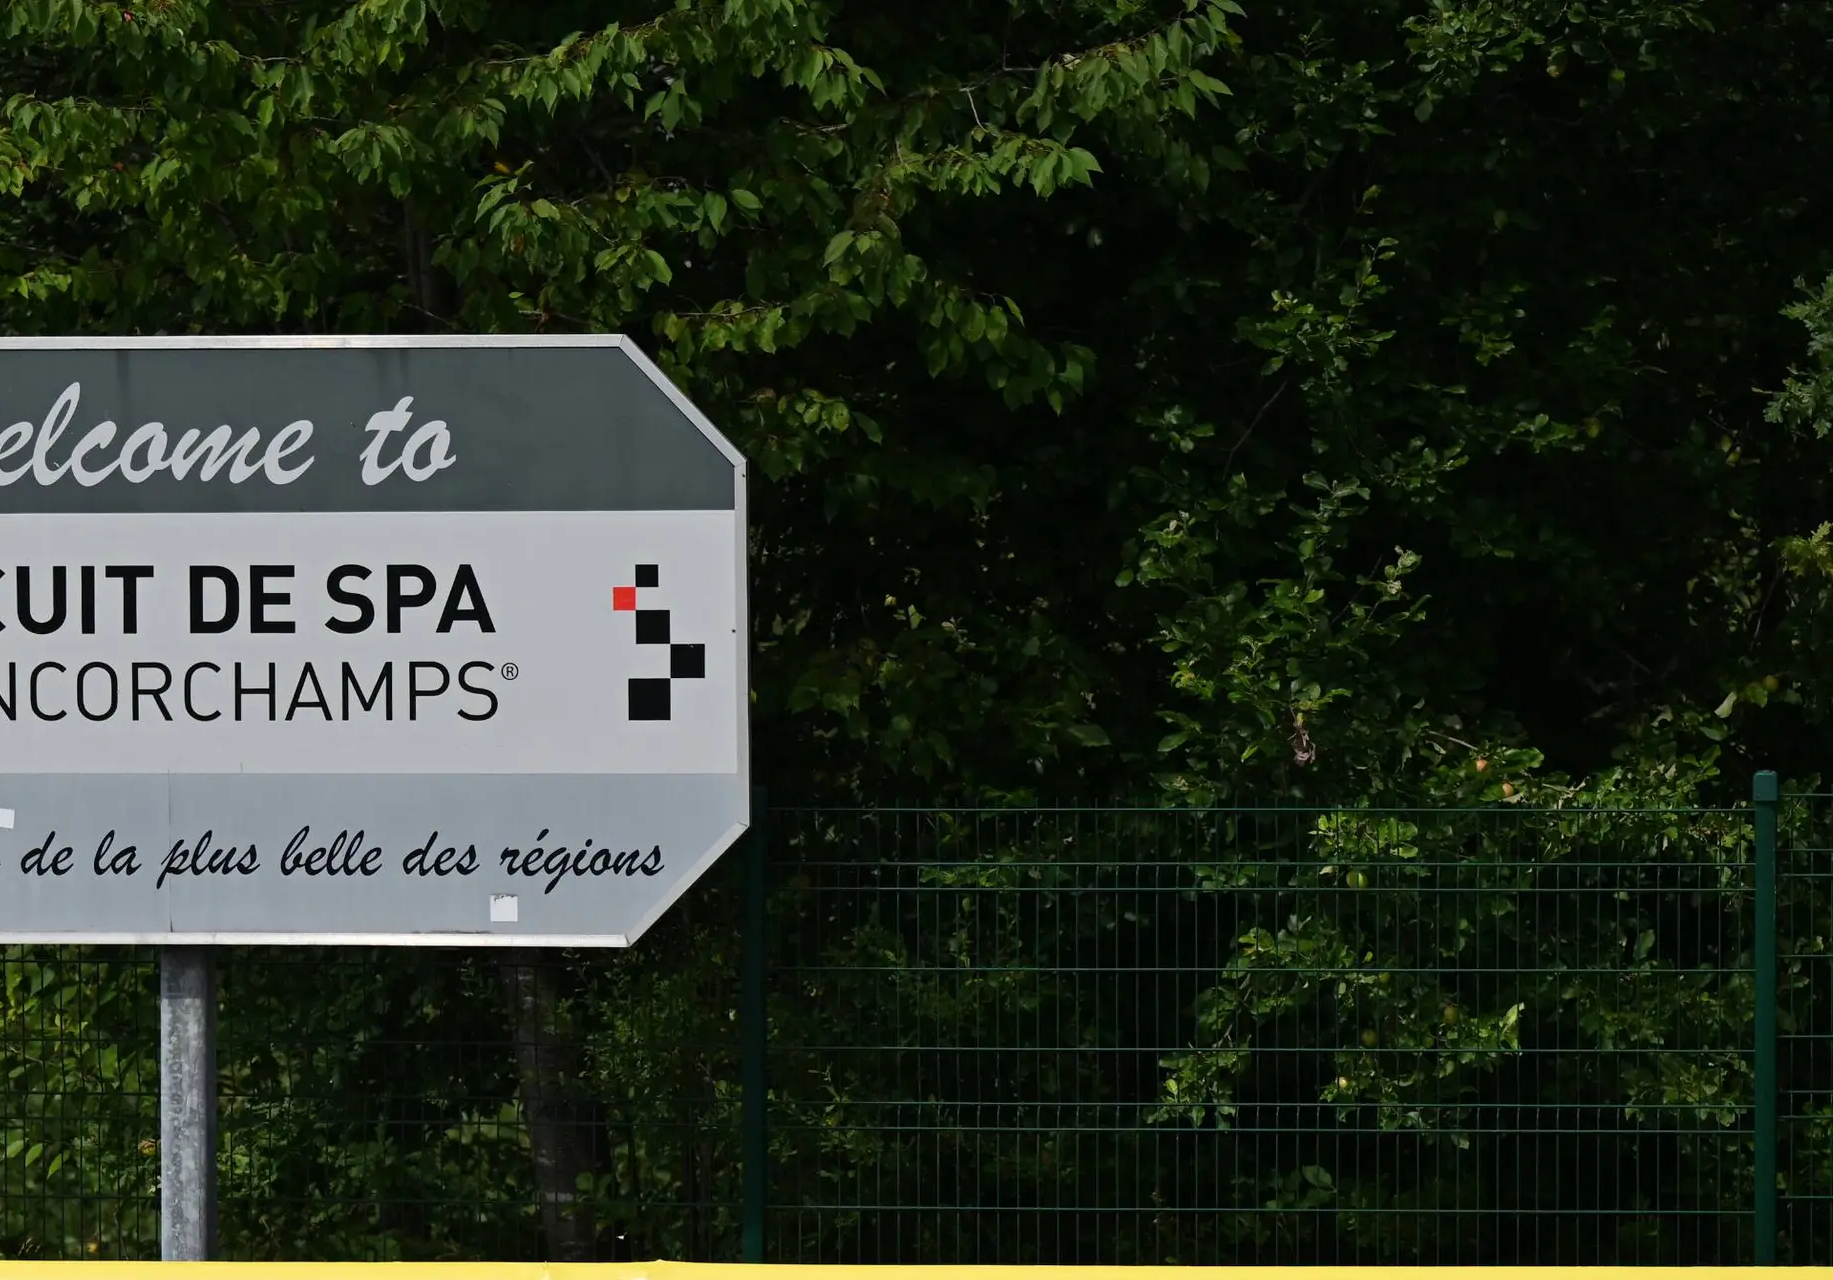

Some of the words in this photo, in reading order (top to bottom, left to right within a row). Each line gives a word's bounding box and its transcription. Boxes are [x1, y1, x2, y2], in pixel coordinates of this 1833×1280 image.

[359, 395, 457, 486] to
[189, 564, 296, 634] DE
[324, 563, 497, 635] SPA
[20, 830, 74, 877] de
[93, 829, 142, 876] la
[156, 829, 261, 890] plus
[280, 825, 383, 877] belle
[402, 830, 481, 877] des
[499, 827, 665, 895] régions
